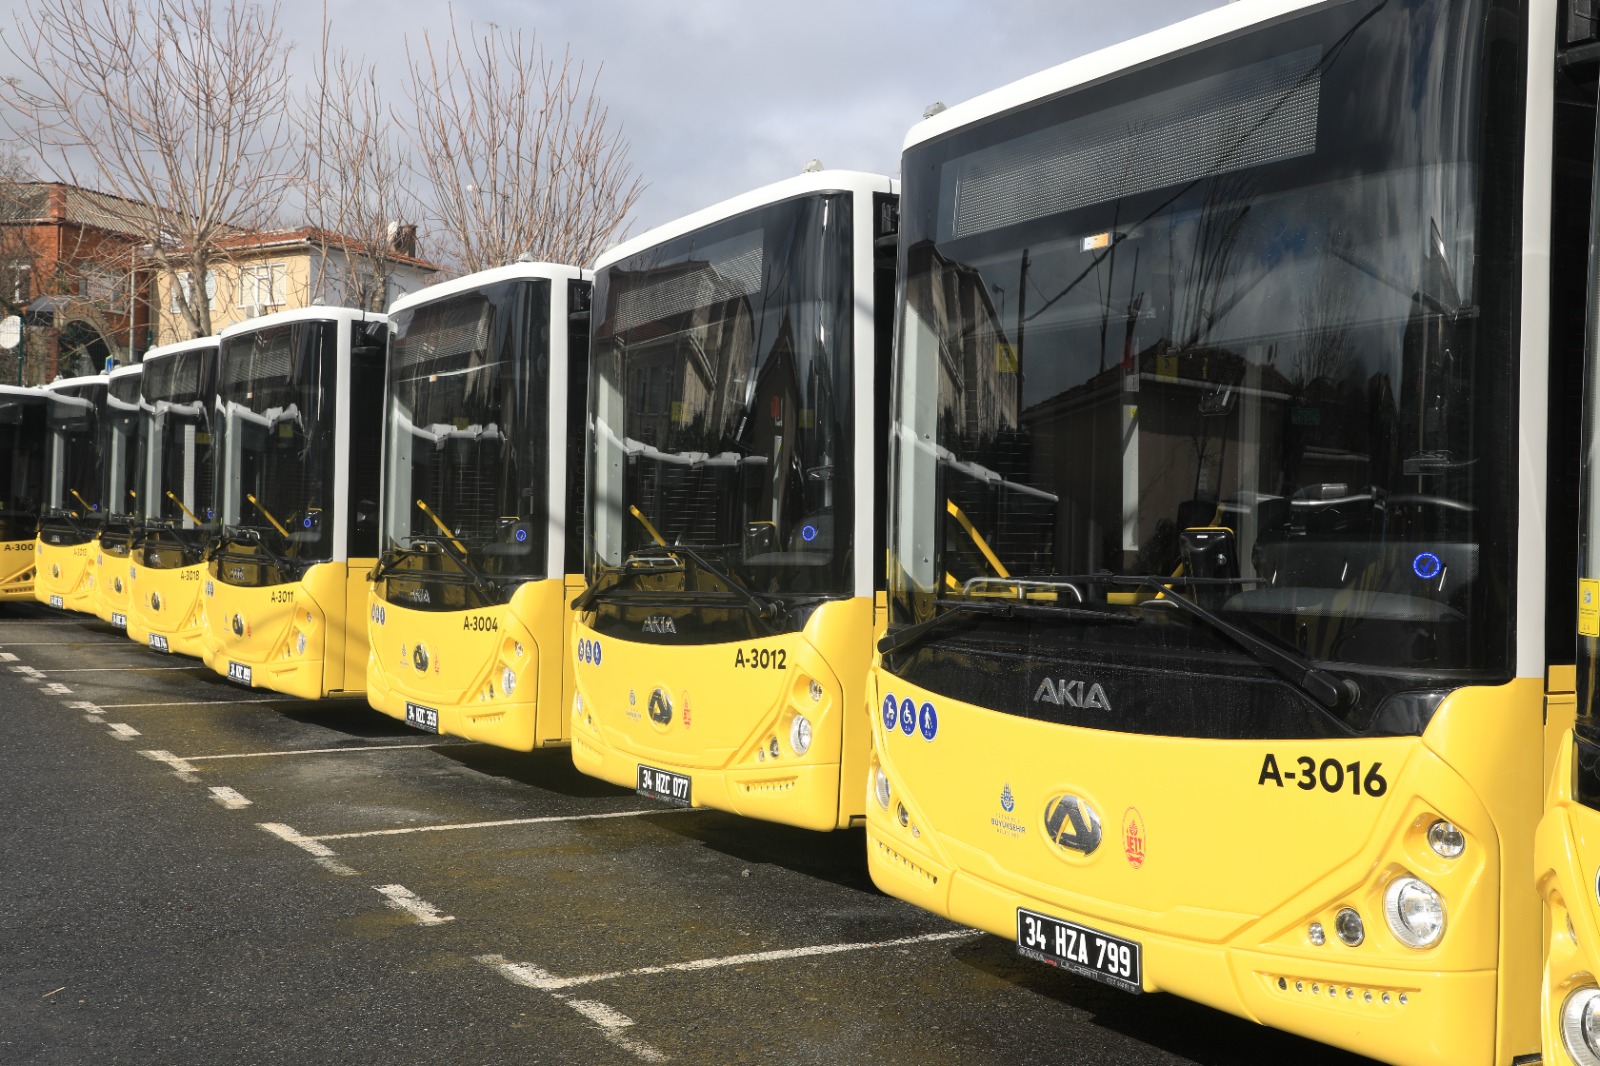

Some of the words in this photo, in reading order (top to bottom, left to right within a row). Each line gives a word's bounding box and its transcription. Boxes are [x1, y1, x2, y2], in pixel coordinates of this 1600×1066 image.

[4, 543, 35, 552] A-300
[180, 570, 200, 581] A-3018
[271, 590, 294, 603] A-3011
[463, 615, 498, 633] A-3004
[641, 615, 677, 634] AKIA
[735, 648, 787, 670] A-3012
[1033, 677, 1112, 711] AKIA
[642, 769, 653, 790] 34
[655, 772, 671, 795] HZC
[672, 776, 689, 799] 077
[1258, 753, 1388, 798] A-3016
[1025, 916, 1047, 950] 34
[1055, 925, 1089, 965] HZA
[1095, 937, 1131, 977] 799
